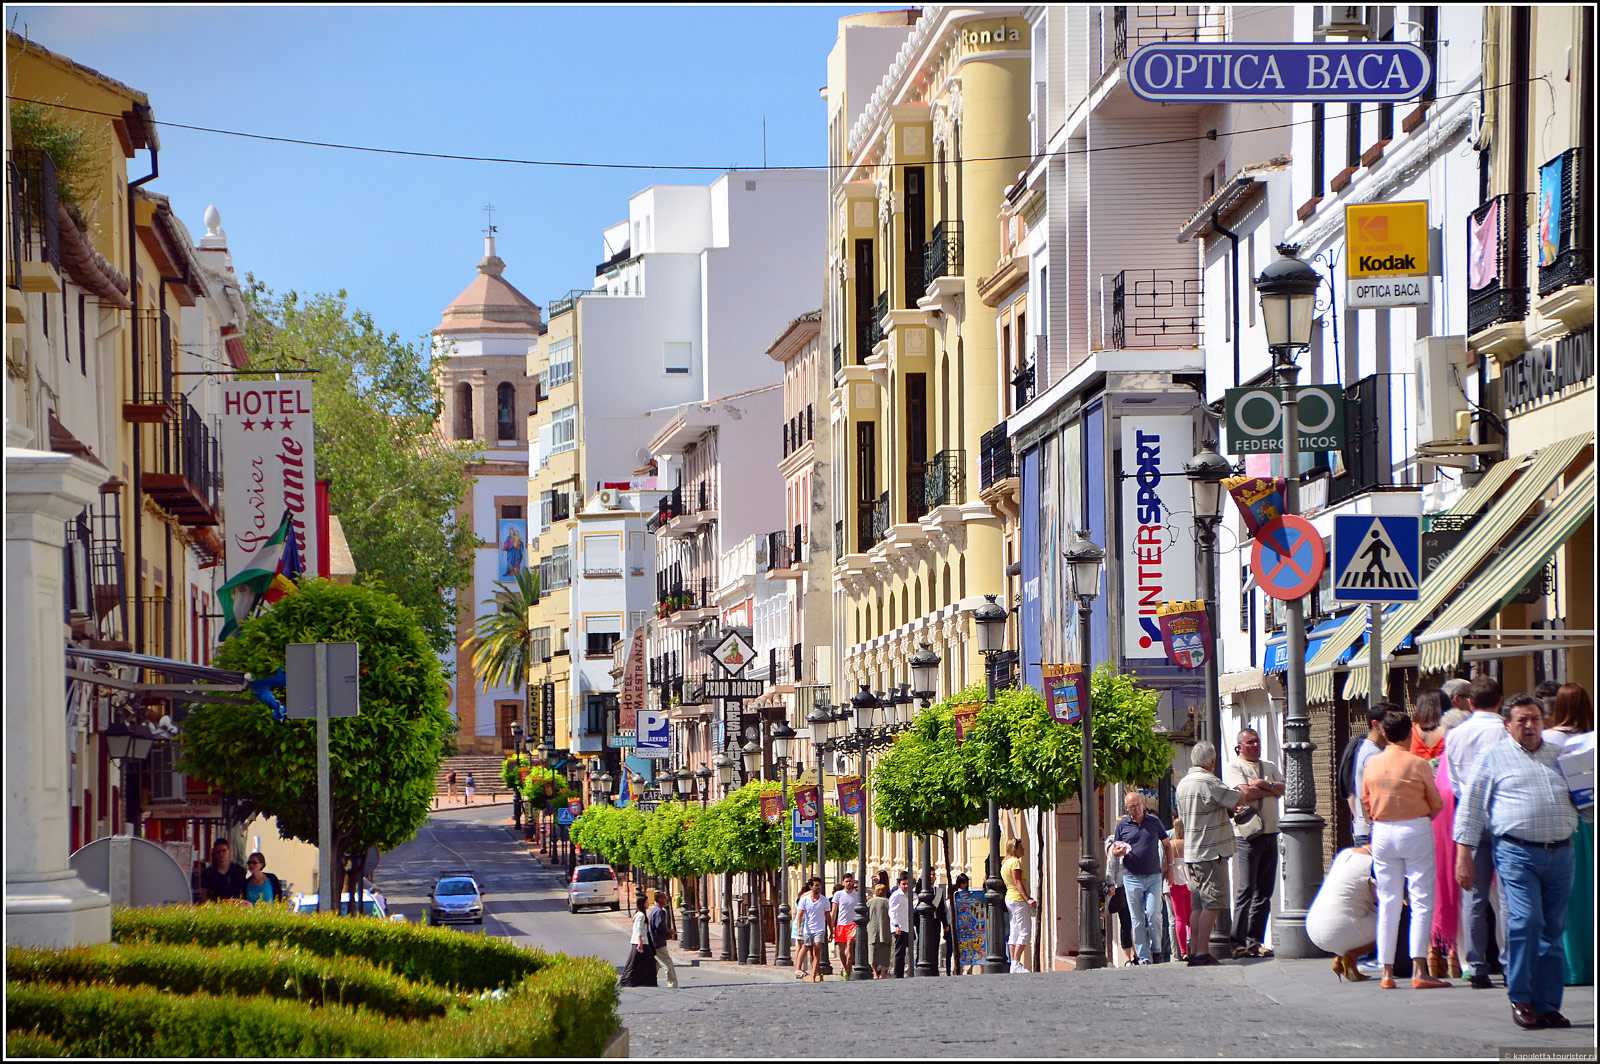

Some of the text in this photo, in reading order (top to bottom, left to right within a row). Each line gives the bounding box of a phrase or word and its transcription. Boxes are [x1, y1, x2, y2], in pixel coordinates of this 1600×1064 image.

[961, 24, 1020, 45] Ronda
[1144, 53, 1410, 89] OPTICA BACA
[1360, 254, 1416, 271] Kodak
[1357, 283, 1421, 298] OPTICA BACA
[225, 389, 310, 415] HOTEL
[1235, 436, 1337, 451] FEDERTICOS
[235, 455, 272, 553] Javier
[1136, 430, 1163, 614] INTERSPORT
[634, 634, 643, 709] MAESTRANZA
[623, 673, 632, 710] HOTEL
[705, 681, 762, 696] PEDRO ROMERO
[530, 686, 539, 737] HOTEL ROYA
[726, 701, 742, 792] RESTAURAN
[190, 798, 218, 806] RIAS
